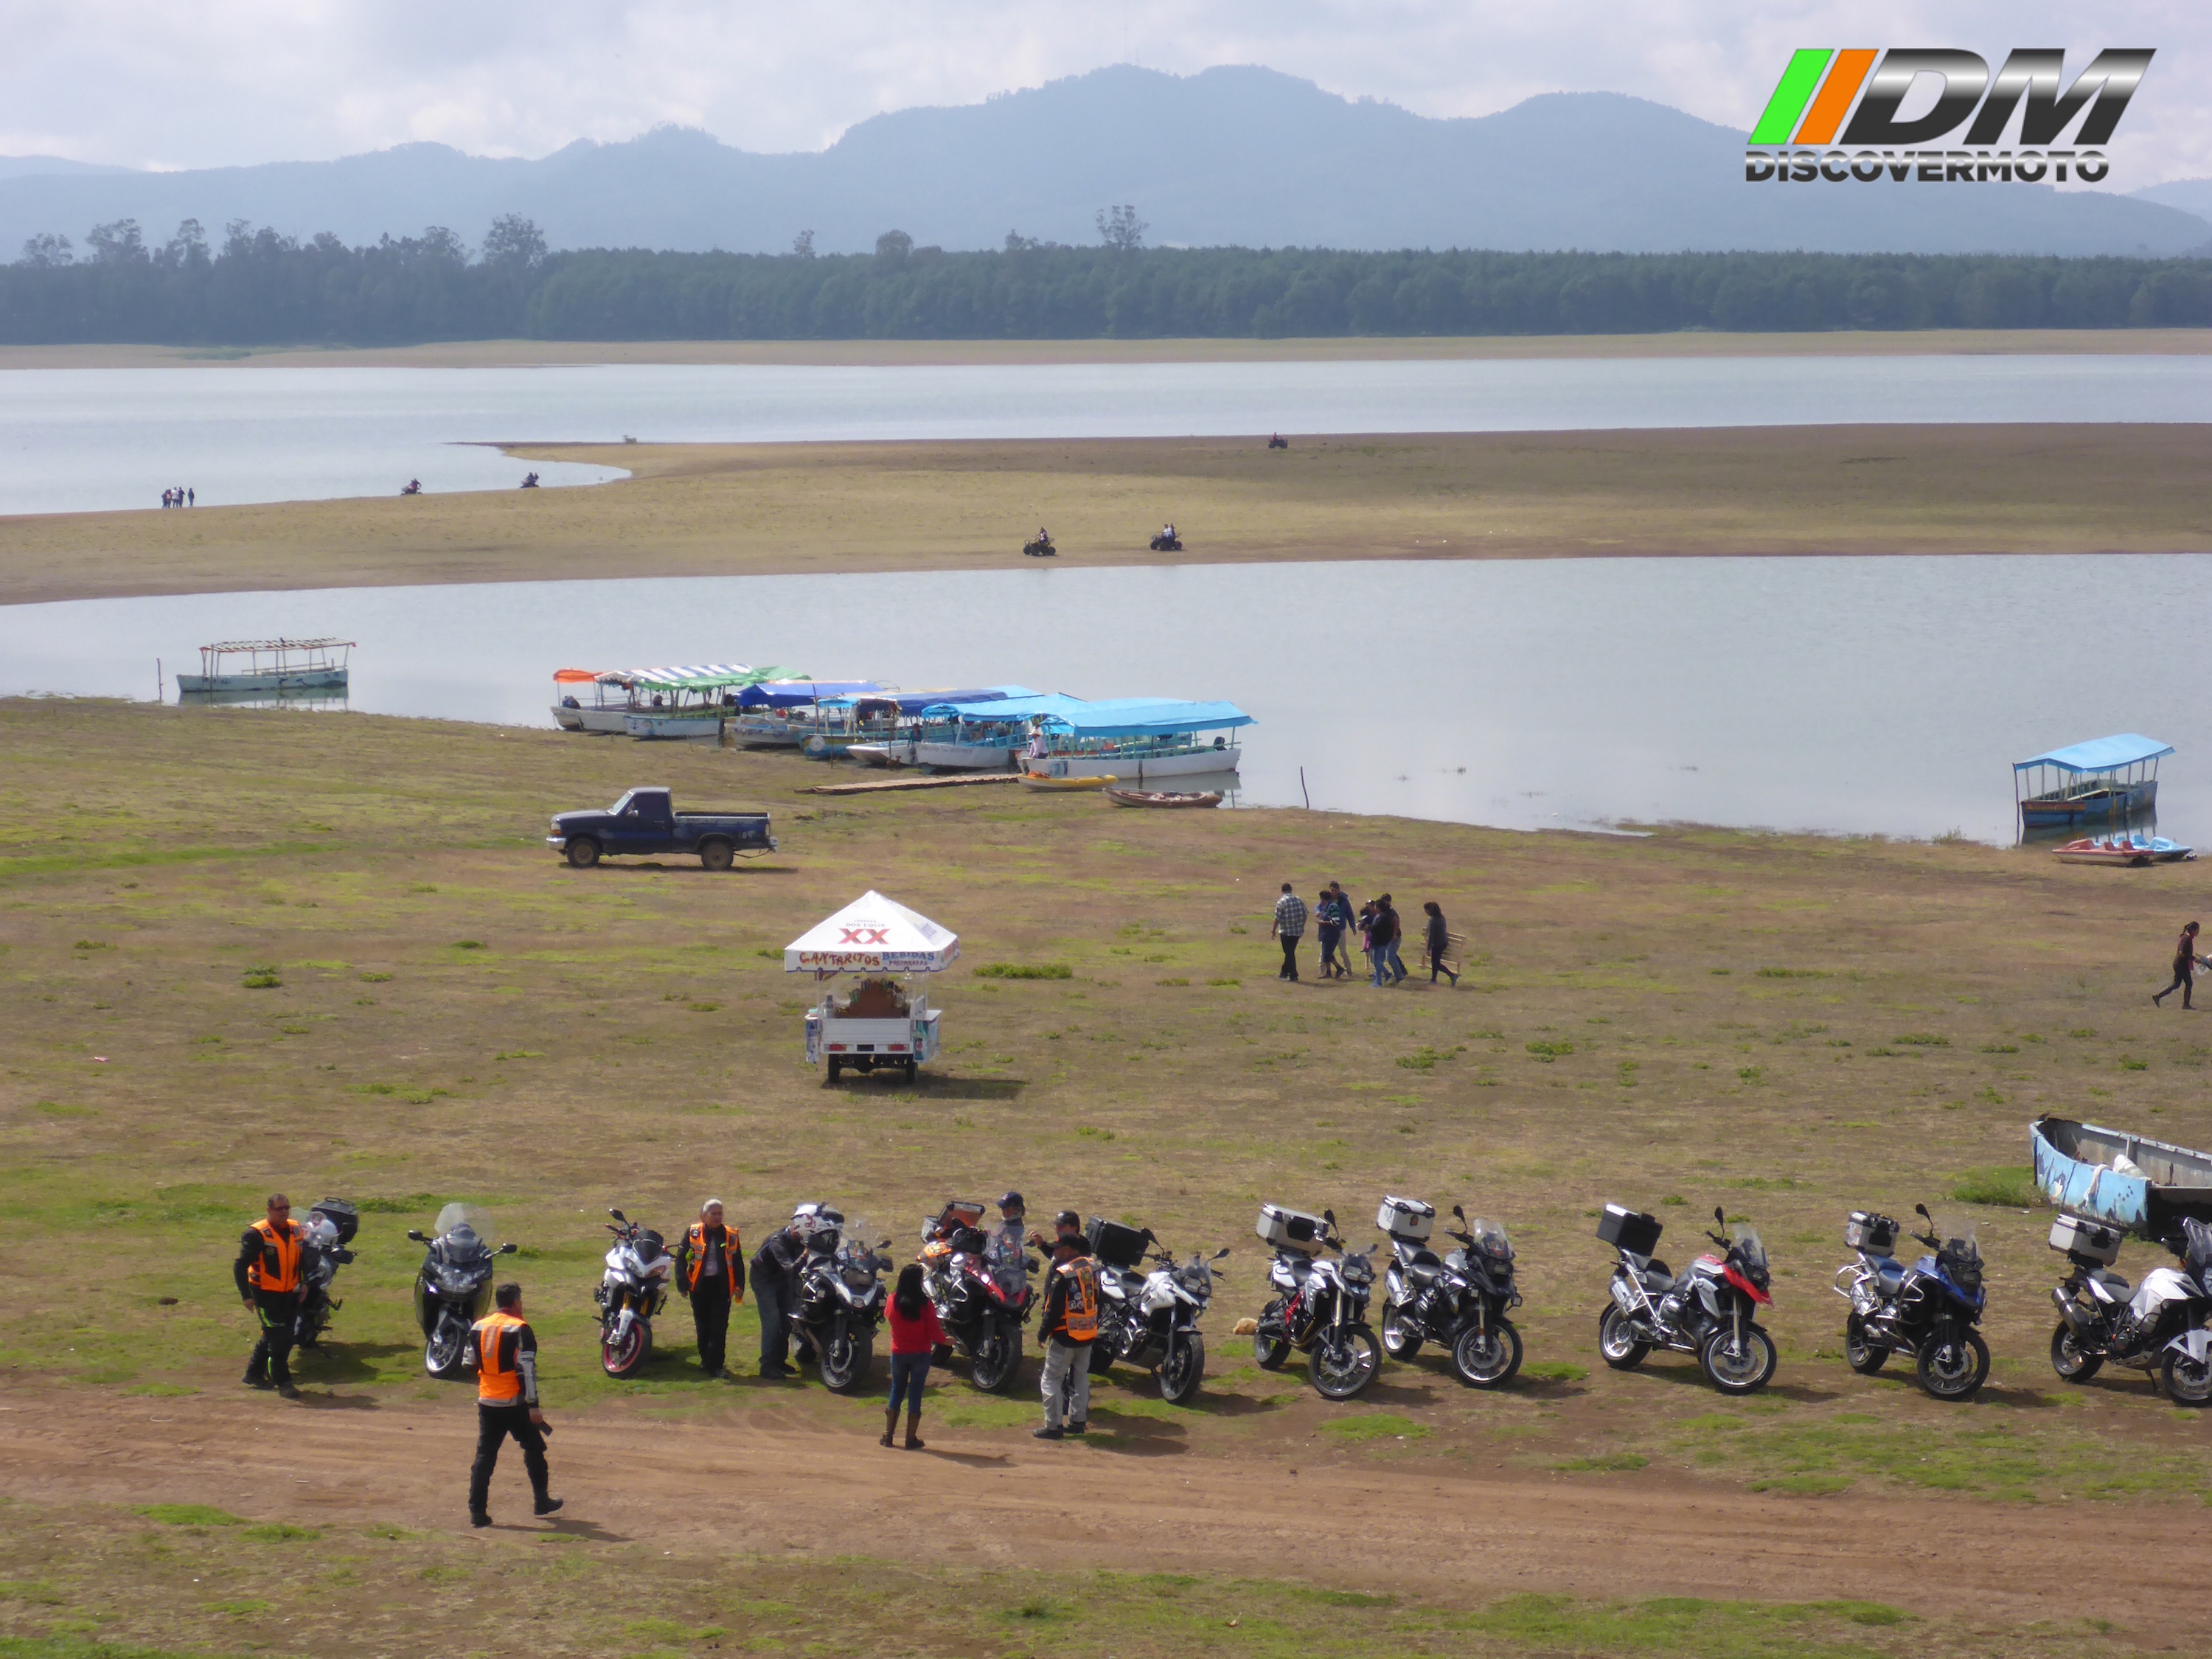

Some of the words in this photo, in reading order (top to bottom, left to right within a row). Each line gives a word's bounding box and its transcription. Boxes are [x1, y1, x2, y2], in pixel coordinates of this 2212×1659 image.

[838, 928, 891, 945] XX
[799, 952, 880, 966] CANTARITOS
[882, 952, 935, 961] BEBIDAS
